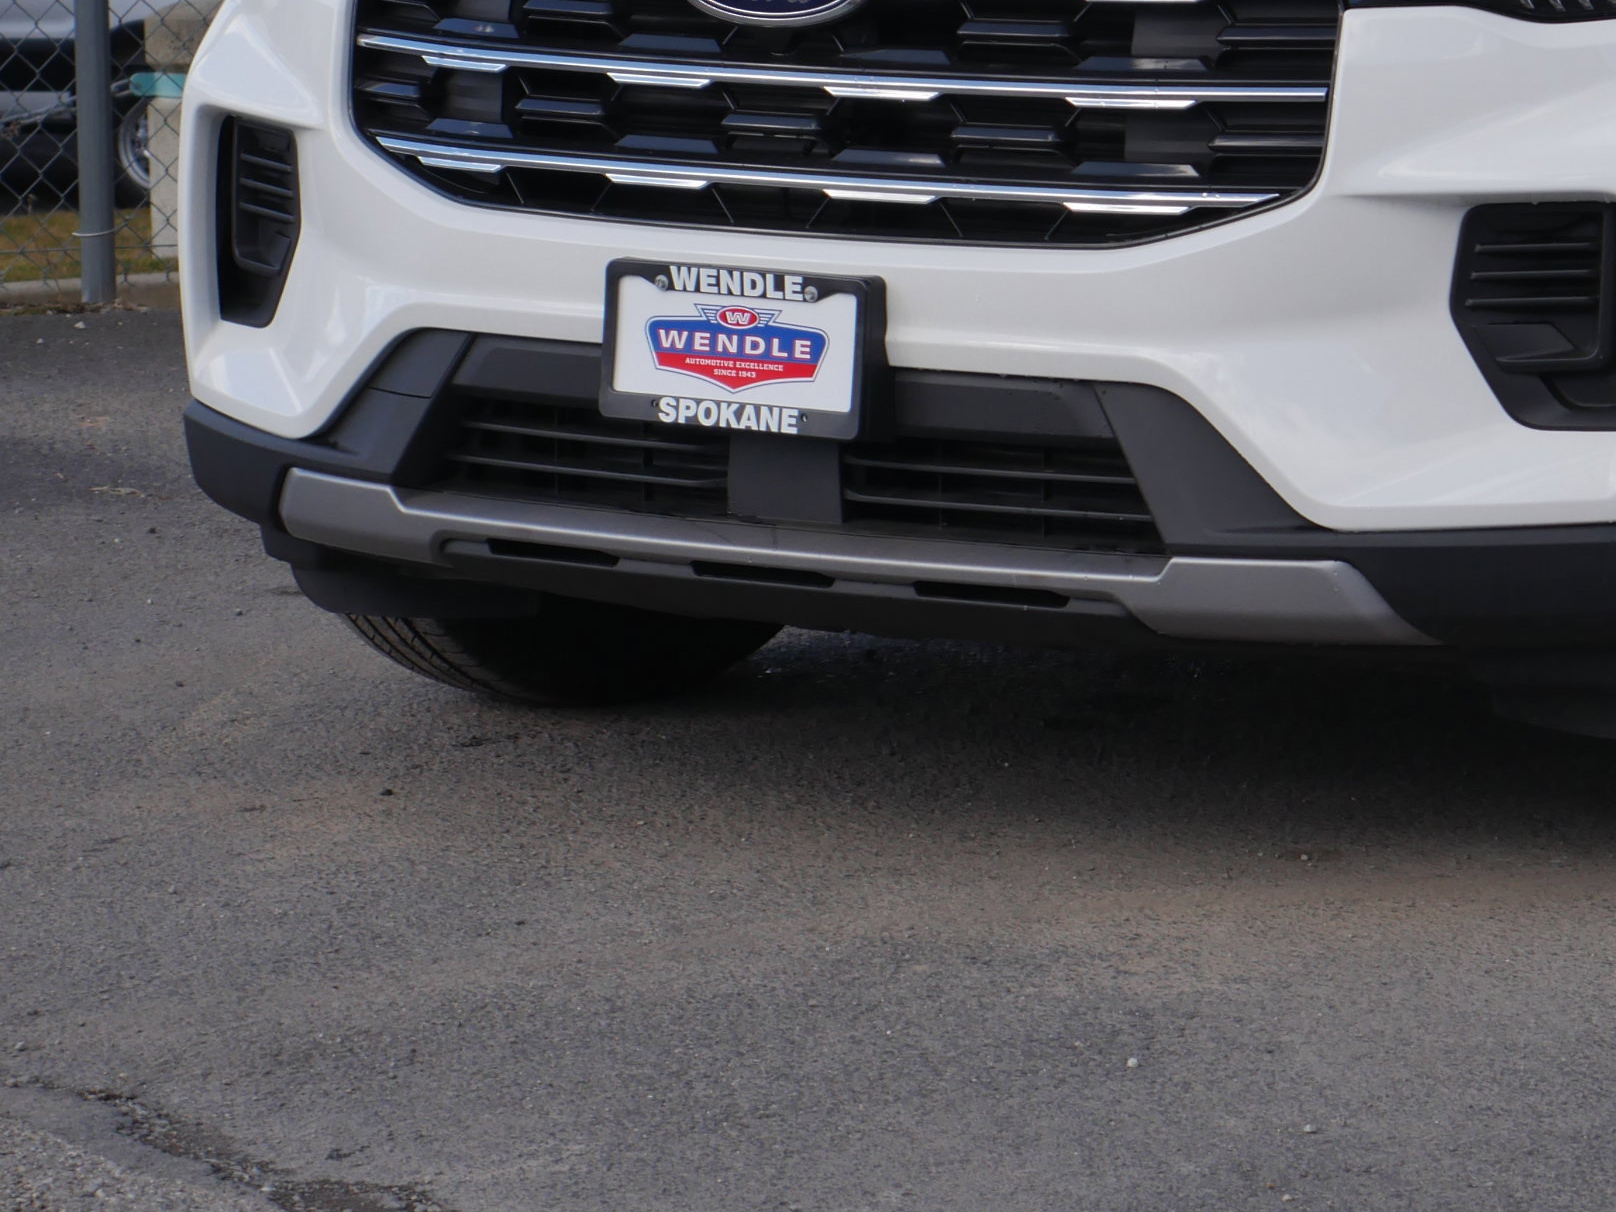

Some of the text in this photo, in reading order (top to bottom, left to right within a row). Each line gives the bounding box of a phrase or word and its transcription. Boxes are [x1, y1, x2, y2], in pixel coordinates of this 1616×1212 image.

[669, 265, 804, 301] WENDLE
[658, 328, 812, 359] WENDLE
[685, 357, 783, 371] AUTOMOTIVE EXCELLENCE
[713, 368, 757, 379] SINCE 1943
[658, 396, 799, 434] SPOKANE
